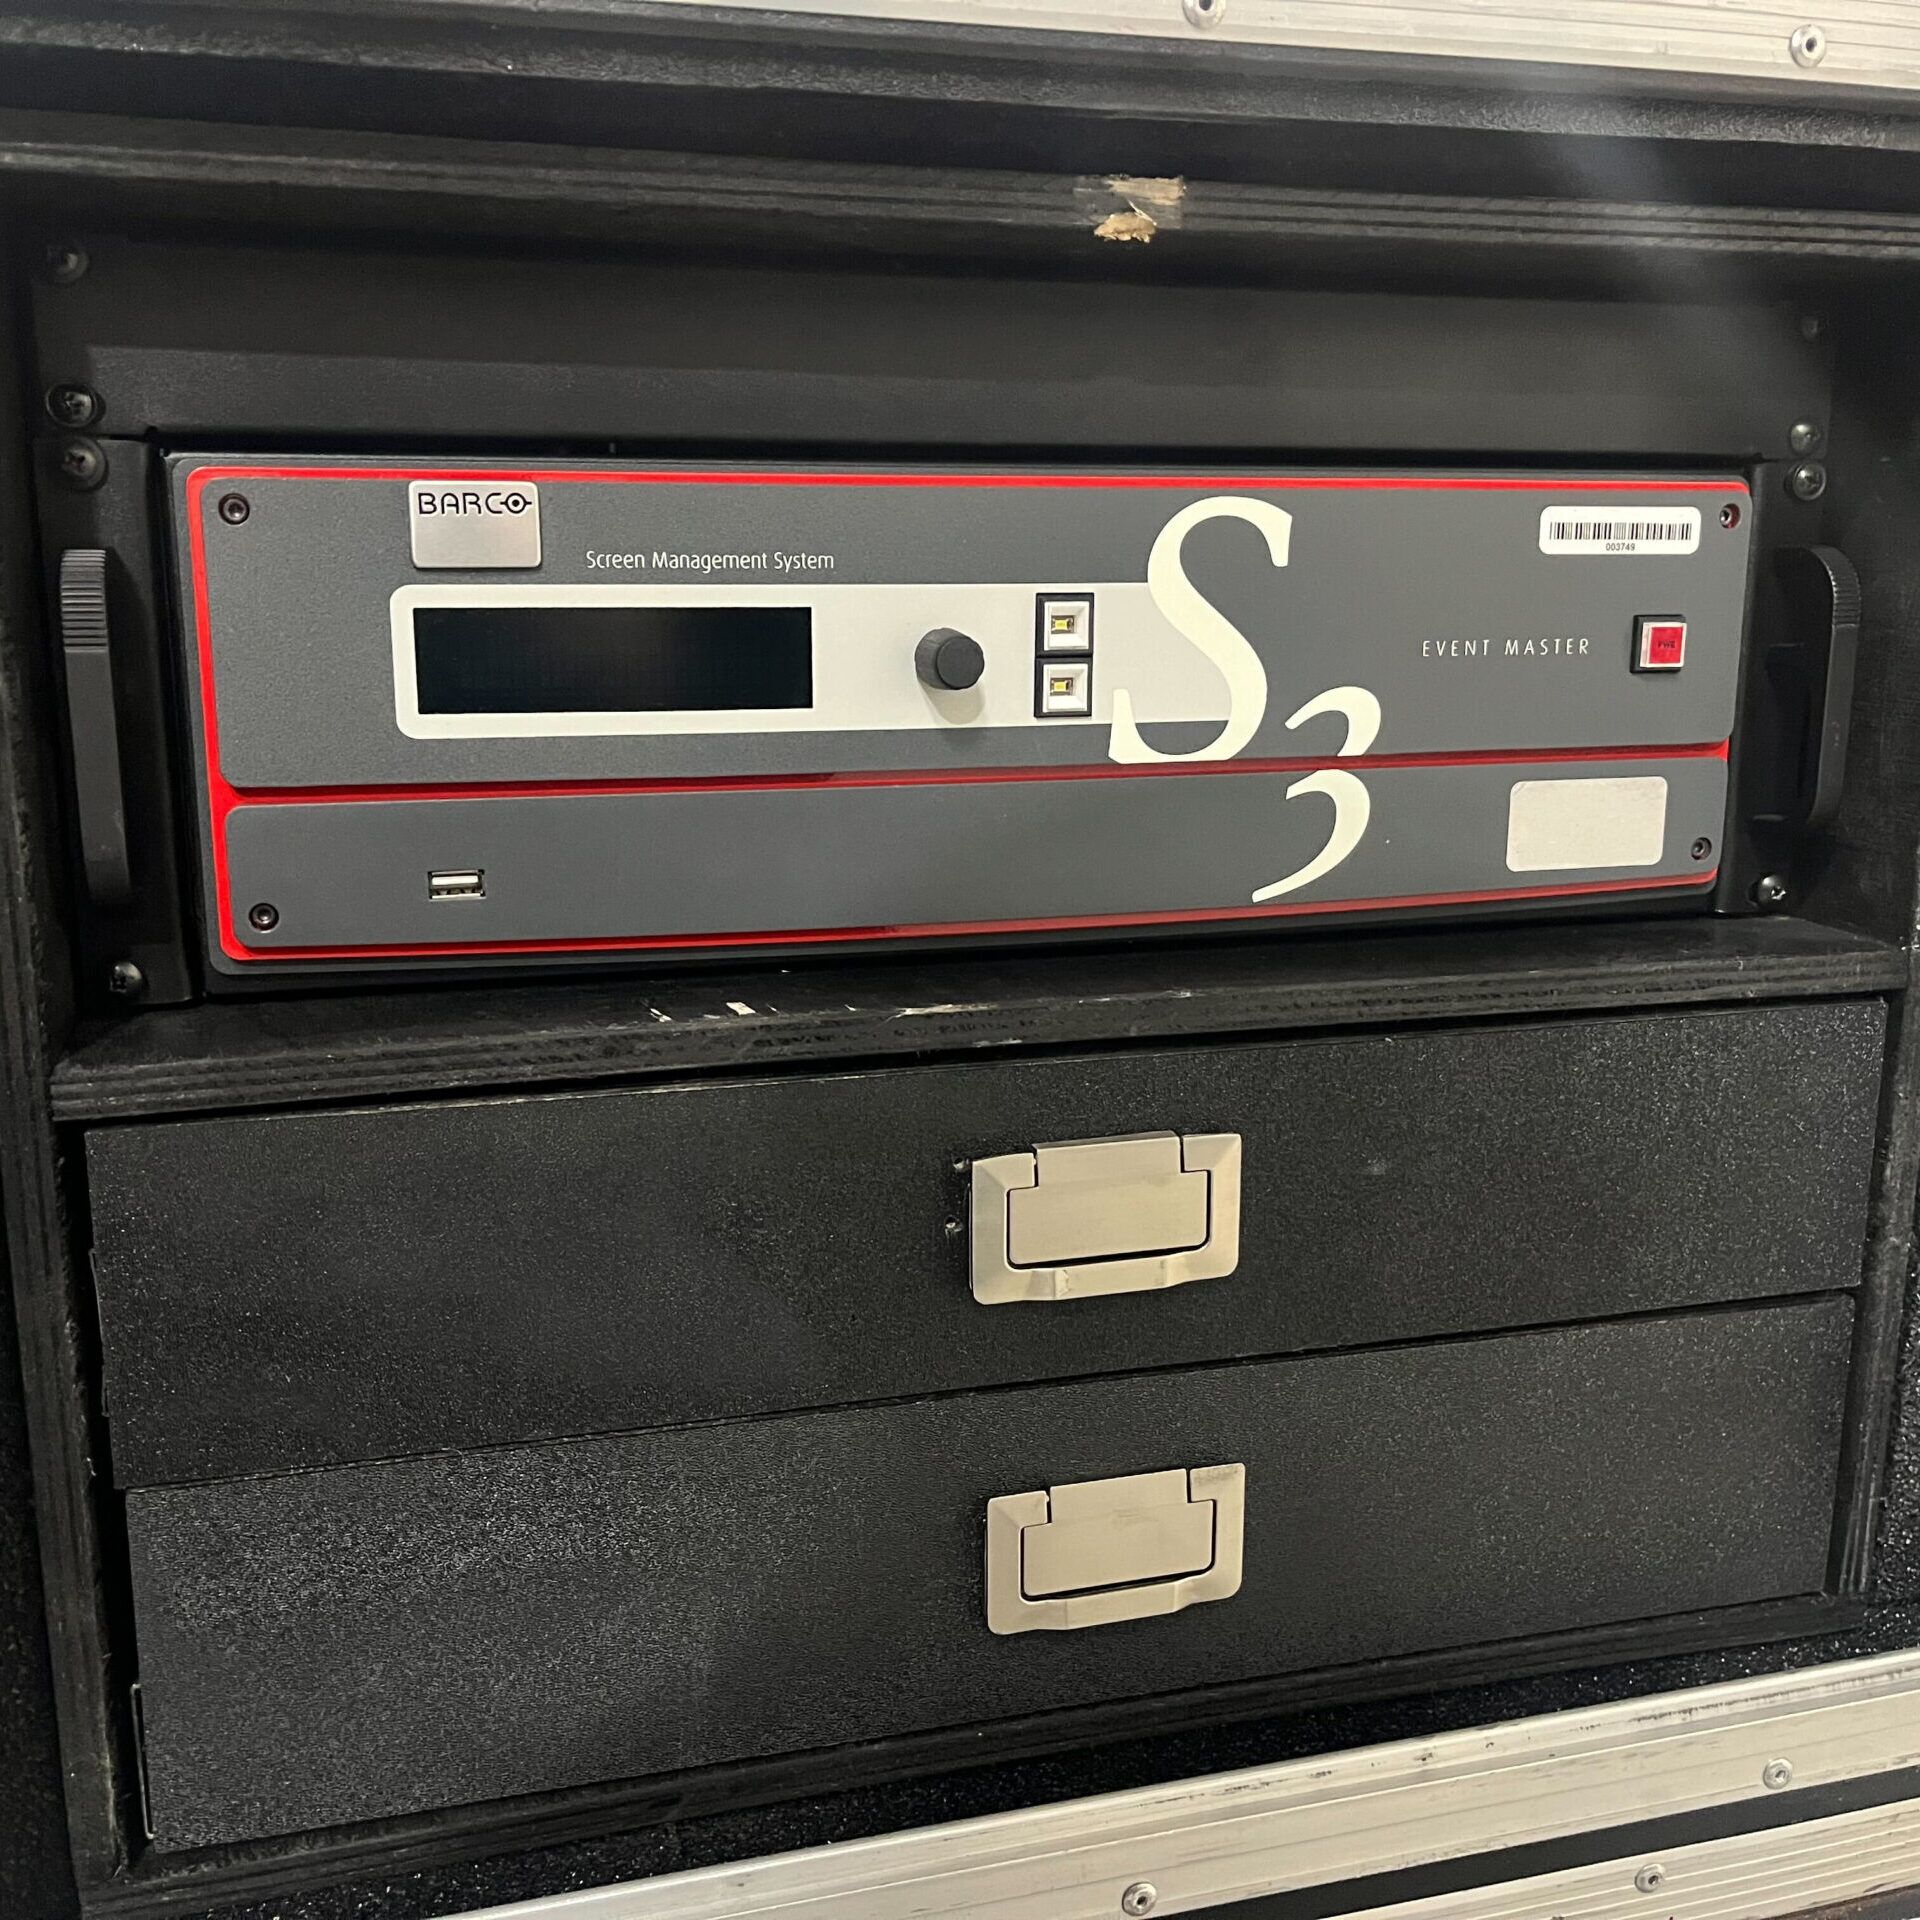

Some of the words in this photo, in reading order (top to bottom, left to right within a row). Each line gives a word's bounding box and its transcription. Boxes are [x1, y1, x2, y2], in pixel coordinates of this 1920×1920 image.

[418, 492, 532, 515] BARCO
[1605, 542, 1636, 552] 003749
[586, 550, 646, 569] Screen
[652, 551, 768, 574] Management
[774, 552, 835, 572] System
[1421, 639, 1490, 657] EVENT
[1504, 637, 1590, 656] MASTER
